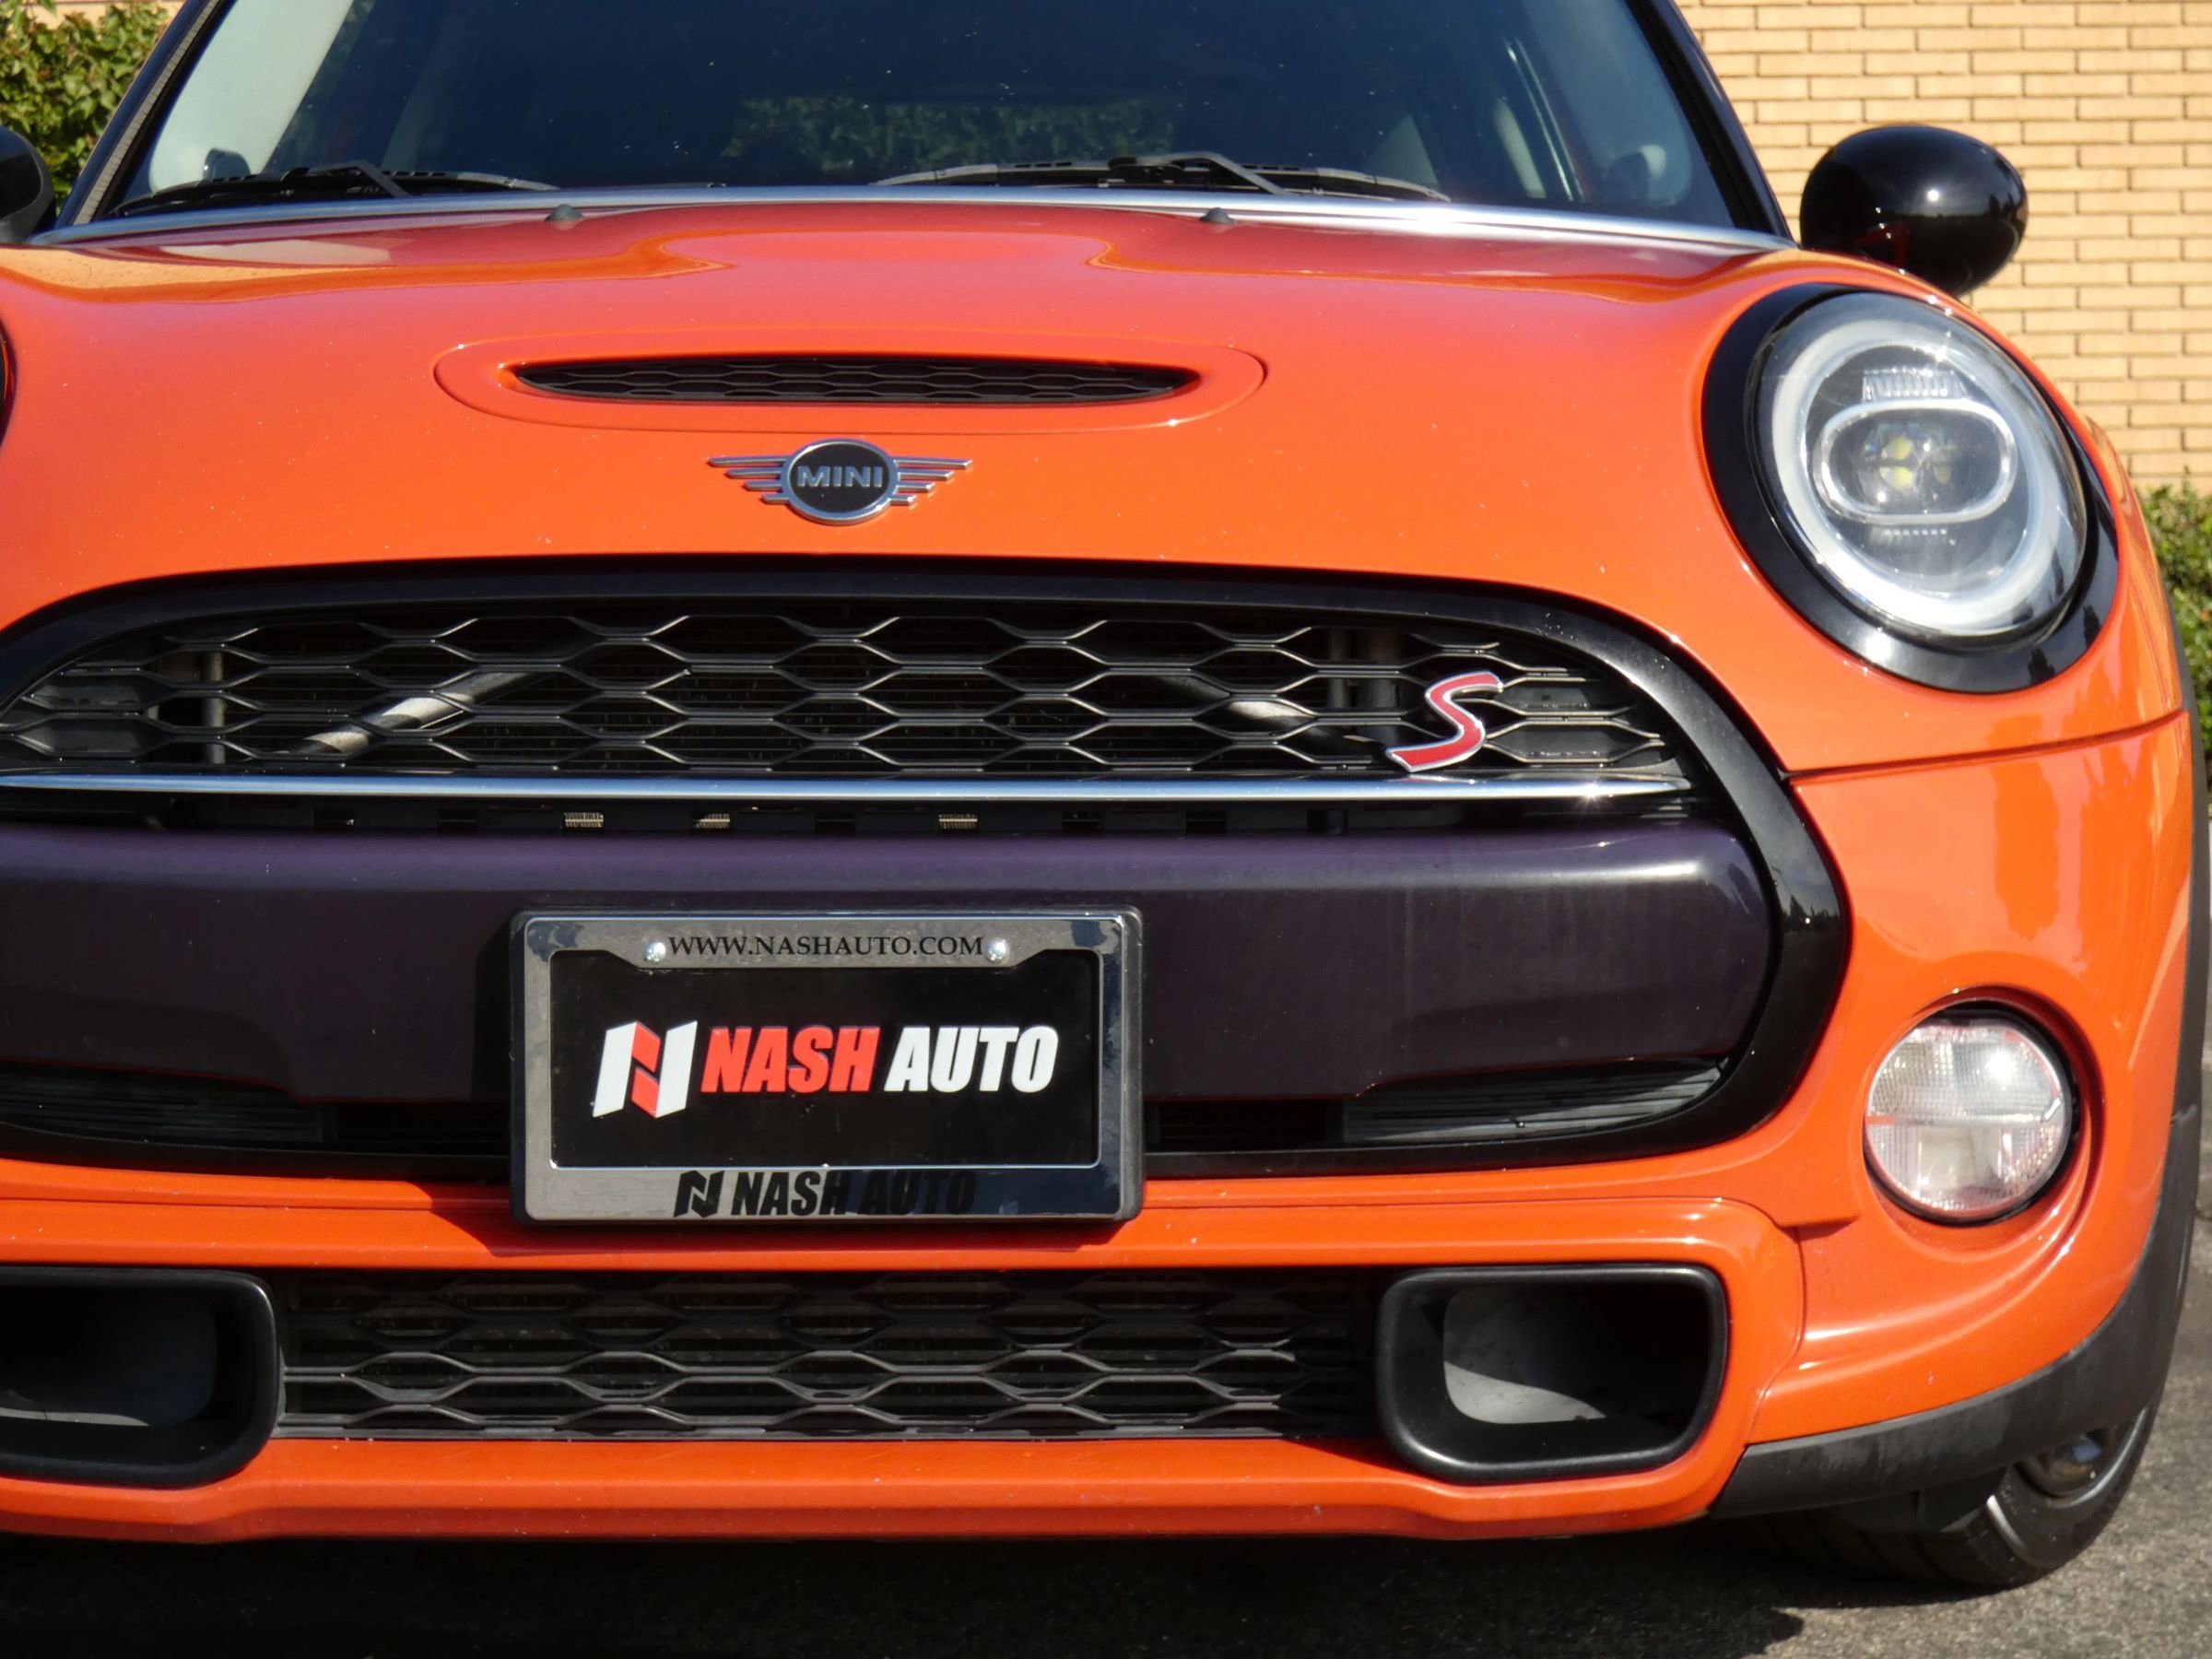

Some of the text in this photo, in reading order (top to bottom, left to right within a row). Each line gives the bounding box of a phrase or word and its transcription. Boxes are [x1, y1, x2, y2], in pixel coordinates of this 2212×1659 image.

[797, 465, 883, 488] MINI
[1385, 670, 1504, 772] S
[668, 935, 982, 957] WWW.NASHAUTO.COM
[700, 1025, 881, 1094] NASH
[884, 1025, 1059, 1094] AUTO
[731, 1170, 849, 1217] NASH
[852, 1170, 977, 1217] AUTO
